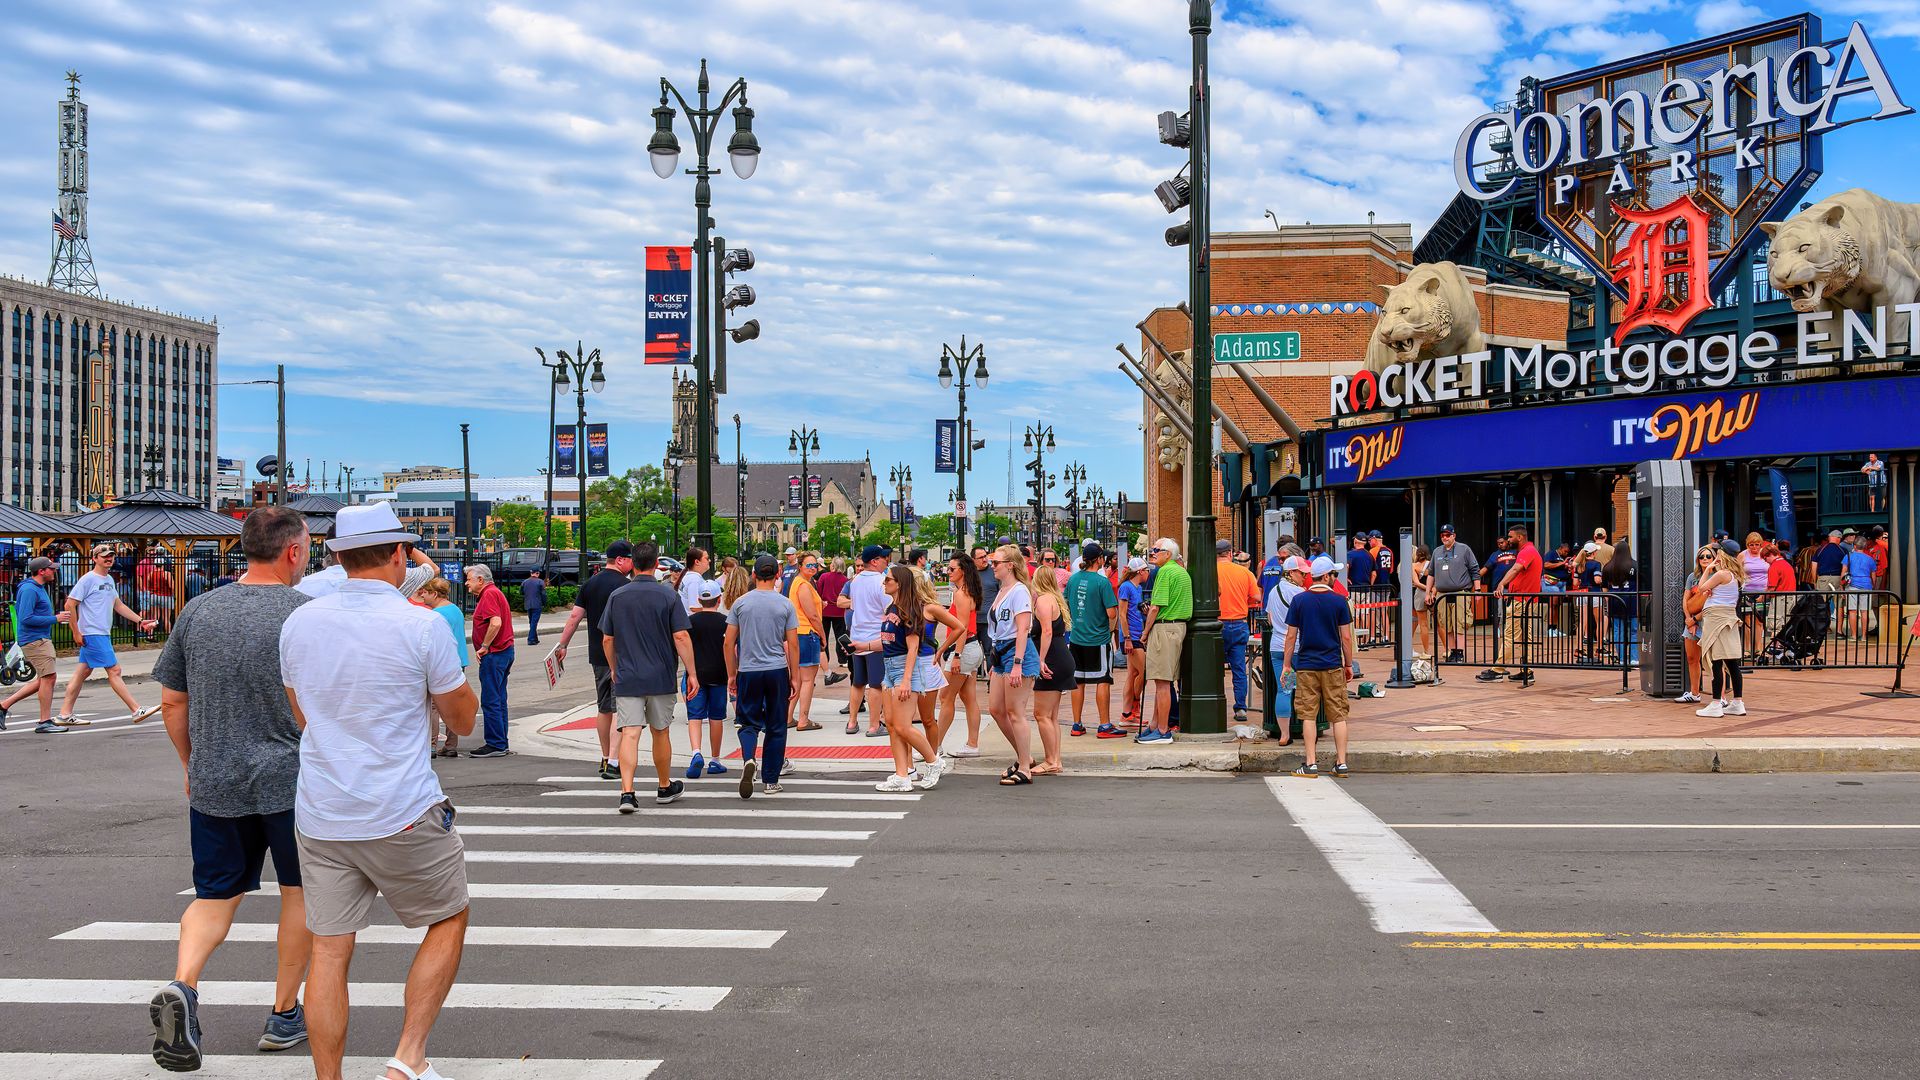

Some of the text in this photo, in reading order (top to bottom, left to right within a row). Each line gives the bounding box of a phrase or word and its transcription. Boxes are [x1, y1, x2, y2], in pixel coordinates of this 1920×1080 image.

[1555, 137, 1765, 206] PARK
[648, 294, 688, 303] ROCKET
[648, 311, 688, 319] ENTRY
[1220, 337, 1295, 358] Adams E
[1330, 350, 1493, 417] ROCKET
[1504, 330, 1778, 394] Mortgage
[91, 360, 102, 494] FOX
[941, 426, 951, 447] MOTOR
[1613, 416, 1659, 446] IT'S
[941, 448, 951, 462] CITY
[1329, 445, 1352, 470] IT'S
[1780, 485, 1789, 512] PICKLR
[1380, 556, 1391, 568] 24
